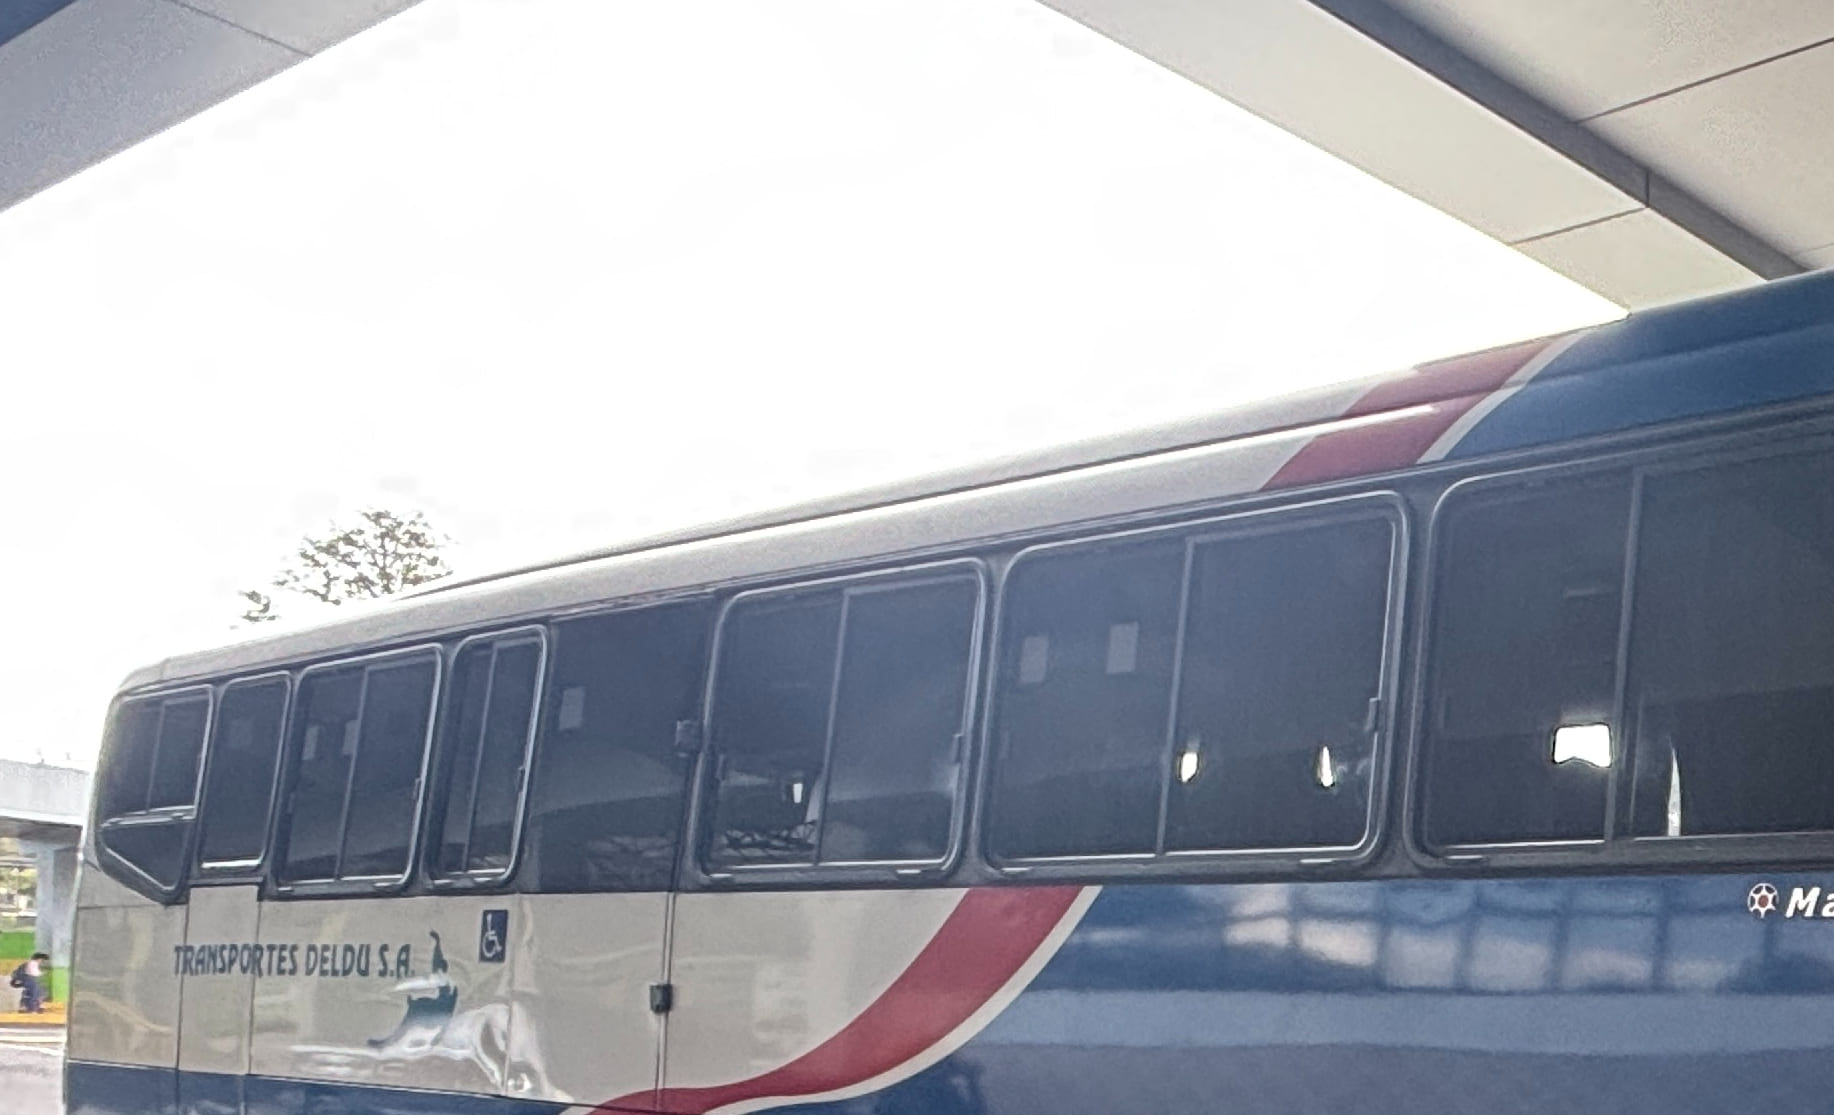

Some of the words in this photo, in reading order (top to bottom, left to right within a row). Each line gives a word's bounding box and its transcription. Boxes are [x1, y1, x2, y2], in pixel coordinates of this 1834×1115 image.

[173, 943, 299, 978] TRANSPORTES
[304, 943, 371, 978] DELDU
[377, 943, 416, 979] S.A.
